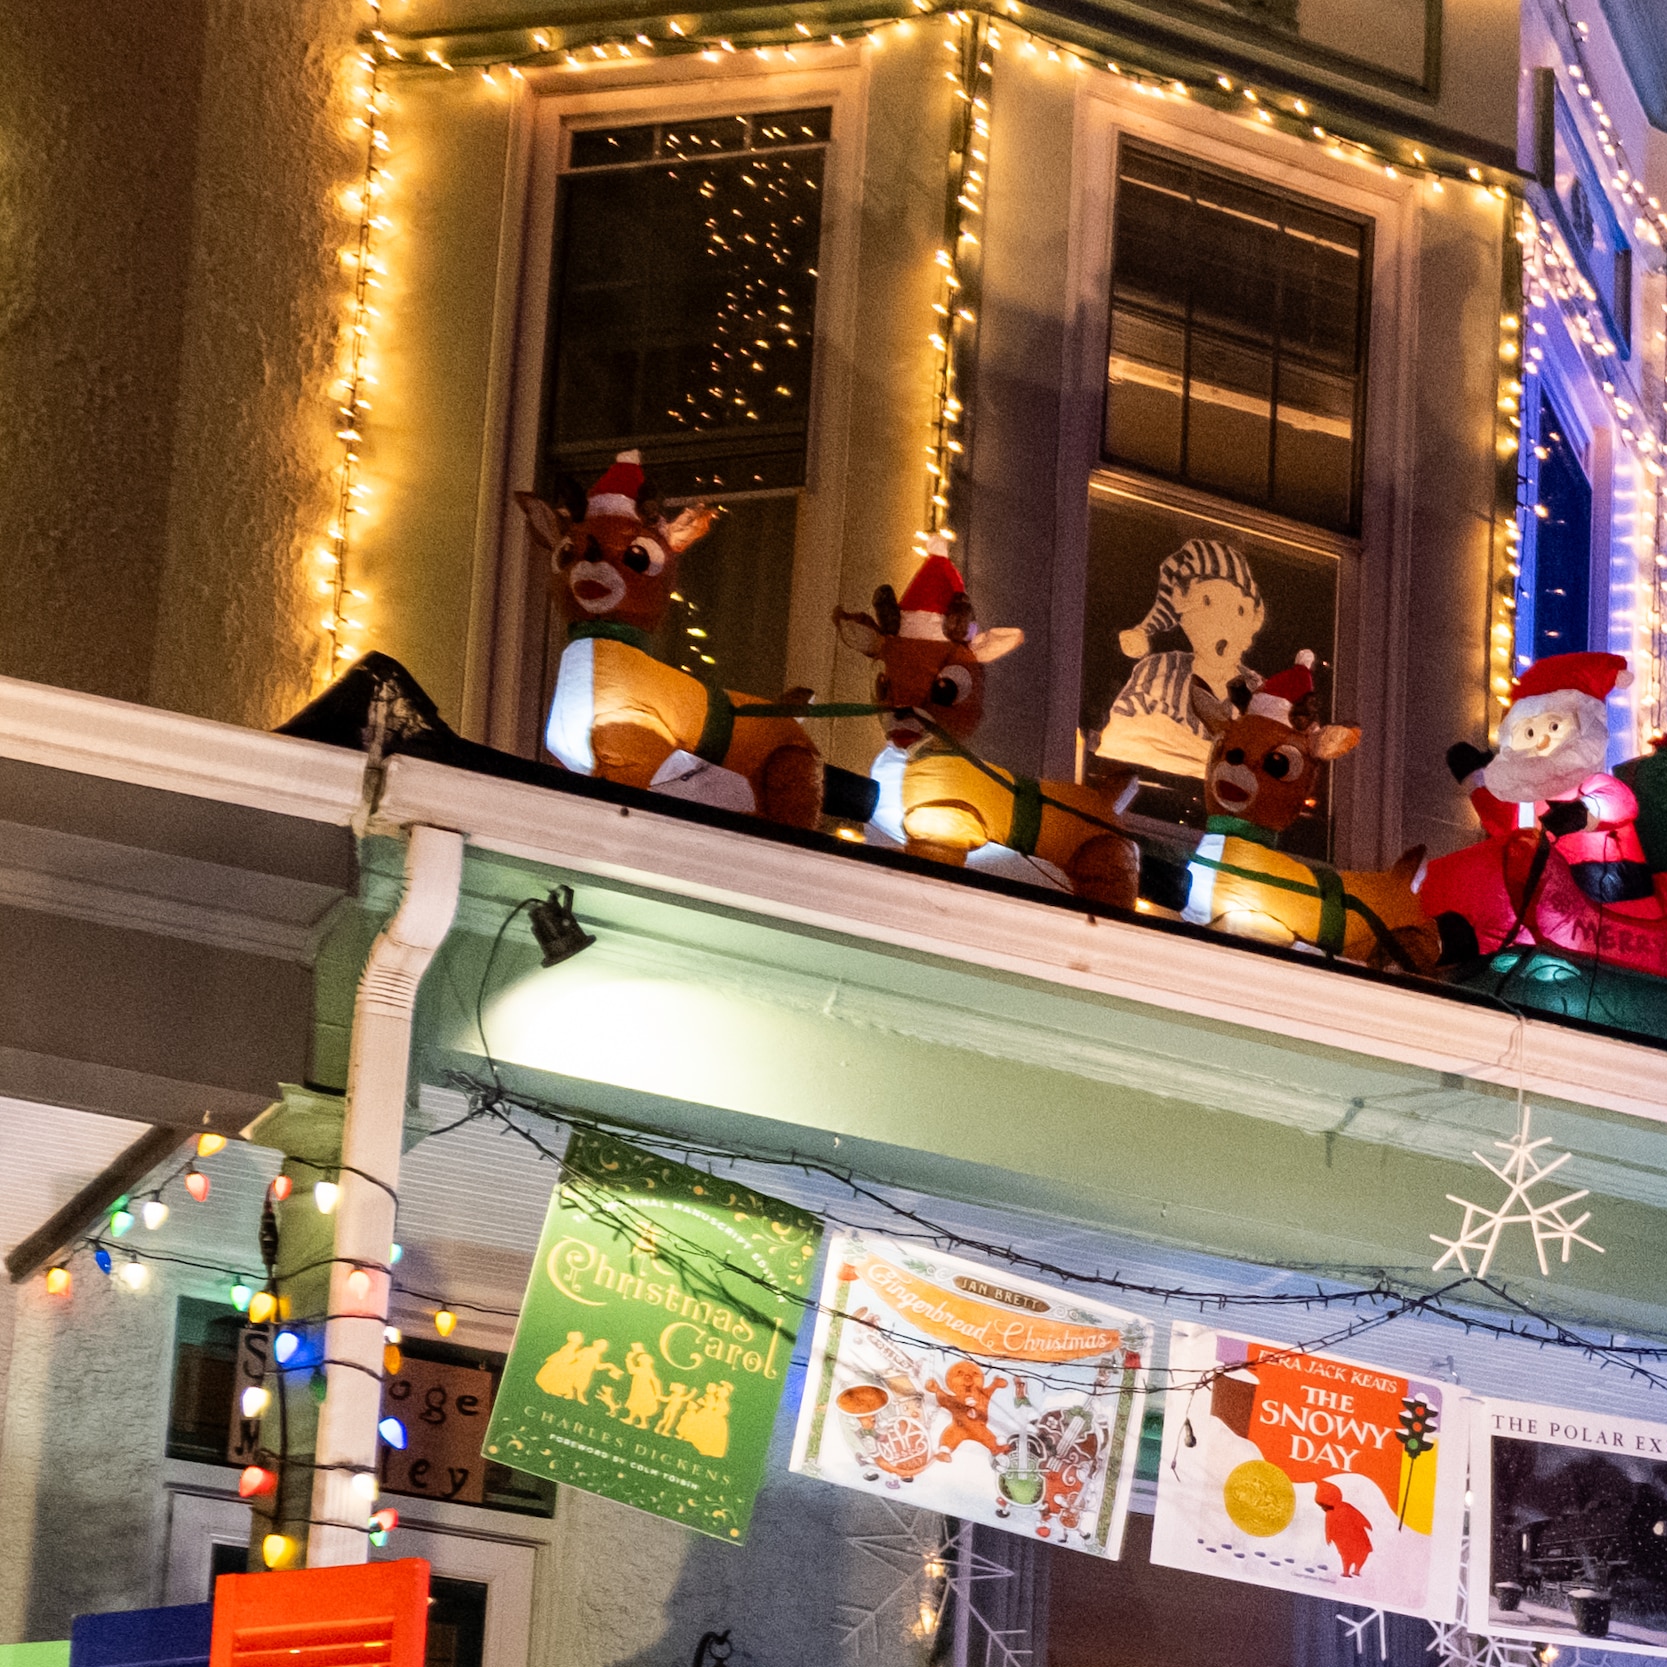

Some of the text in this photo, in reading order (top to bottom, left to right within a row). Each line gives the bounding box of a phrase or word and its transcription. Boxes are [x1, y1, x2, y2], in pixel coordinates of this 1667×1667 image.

[672, 1202, 753, 1250] MANUSCRIPT
[547, 1235, 754, 1342] Christmas
[868, 1264, 1008, 1354] Gingerbread
[993, 1319, 1112, 1352] Christmas
[960, 1278, 1040, 1310] JAN BRETT
[660, 1317, 784, 1379] Carol
[1305, 1360, 1347, 1382] JACK
[1351, 1370, 1398, 1393] KEATS
[1300, 1385, 1355, 1413] THE
[524, 1405, 731, 1485] CHARLES DICKENS
[549, 1433, 609, 1459] FOREWORD
[1259, 1399, 1393, 1450] SNOWY
[1491, 1413, 1538, 1434] THE
[1549, 1422, 1625, 1447] POLAR
[1288, 1434, 1361, 1472] DAY
